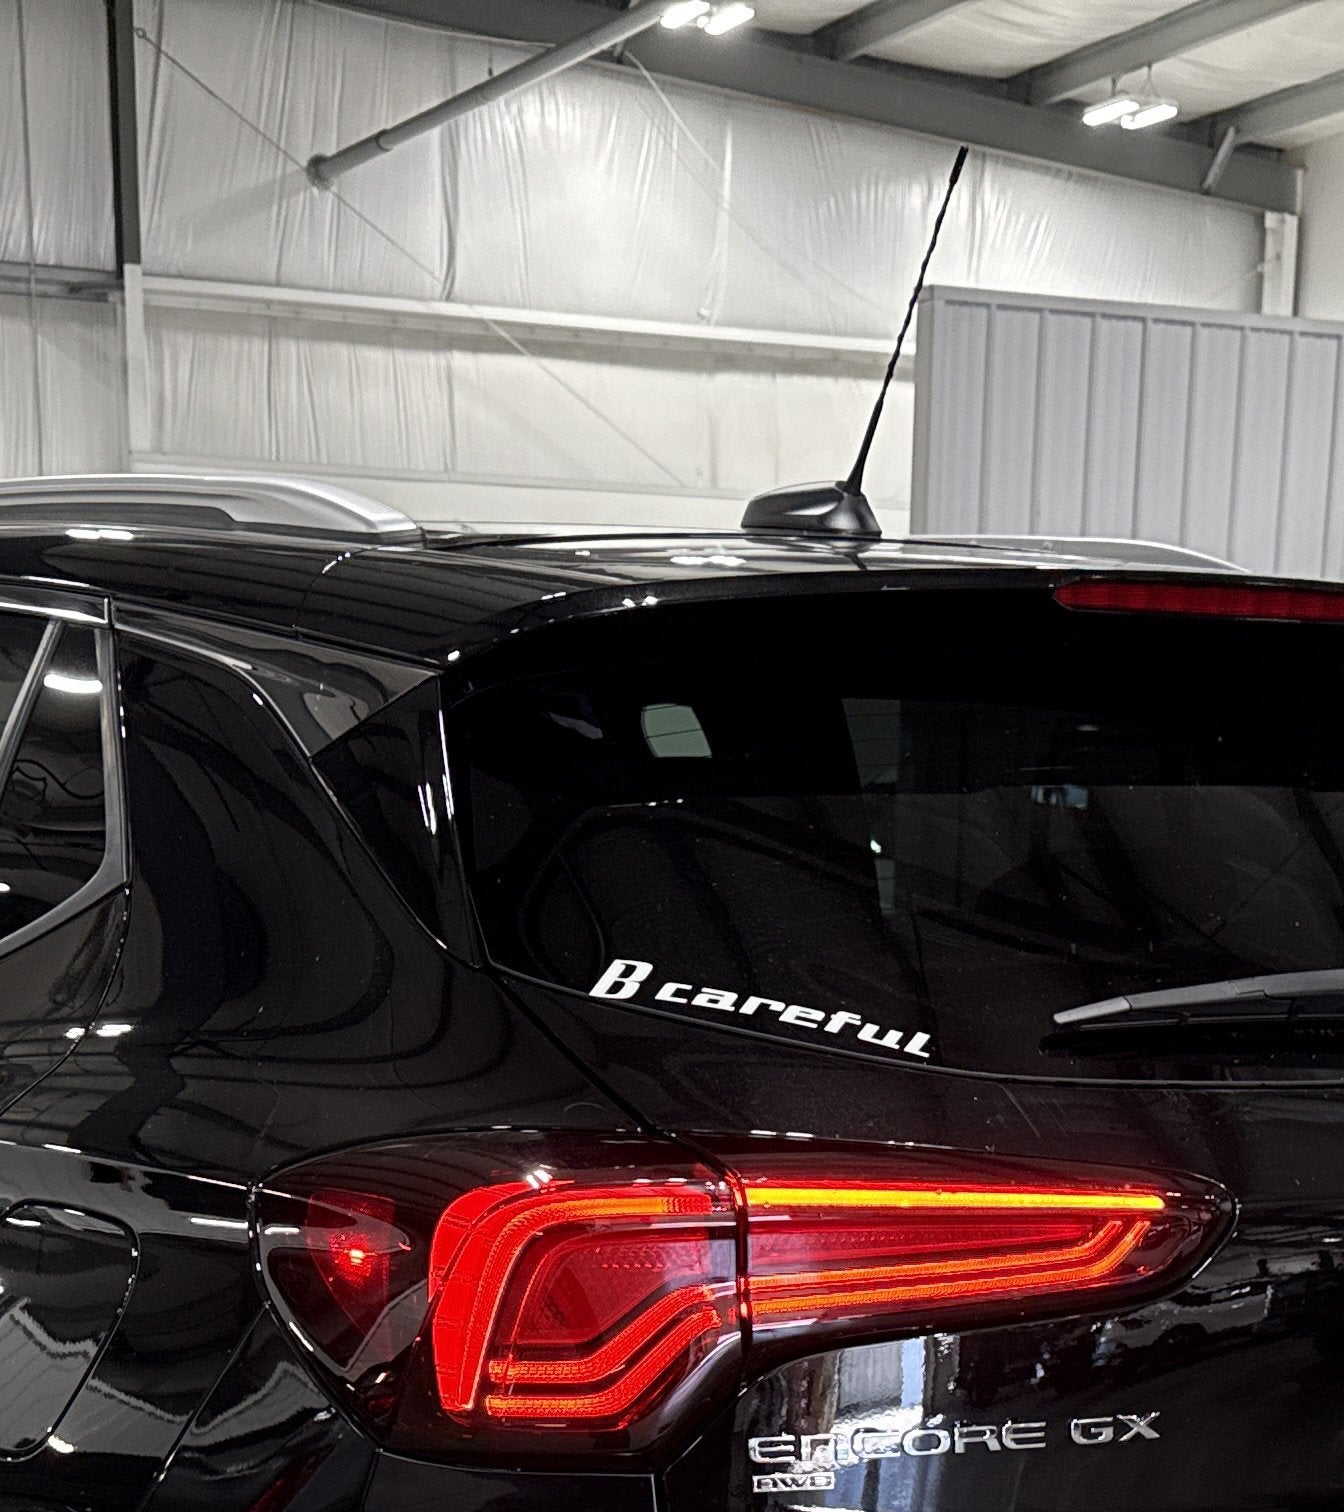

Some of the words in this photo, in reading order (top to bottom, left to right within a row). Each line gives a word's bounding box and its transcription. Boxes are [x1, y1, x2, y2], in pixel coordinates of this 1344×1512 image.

[589, 958, 654, 1000] B
[654, 981, 931, 1058] careful
[748, 1419, 1047, 1464] ENCORE
[1069, 1411, 1161, 1445] GX
[754, 1473, 834, 1493] AWD
